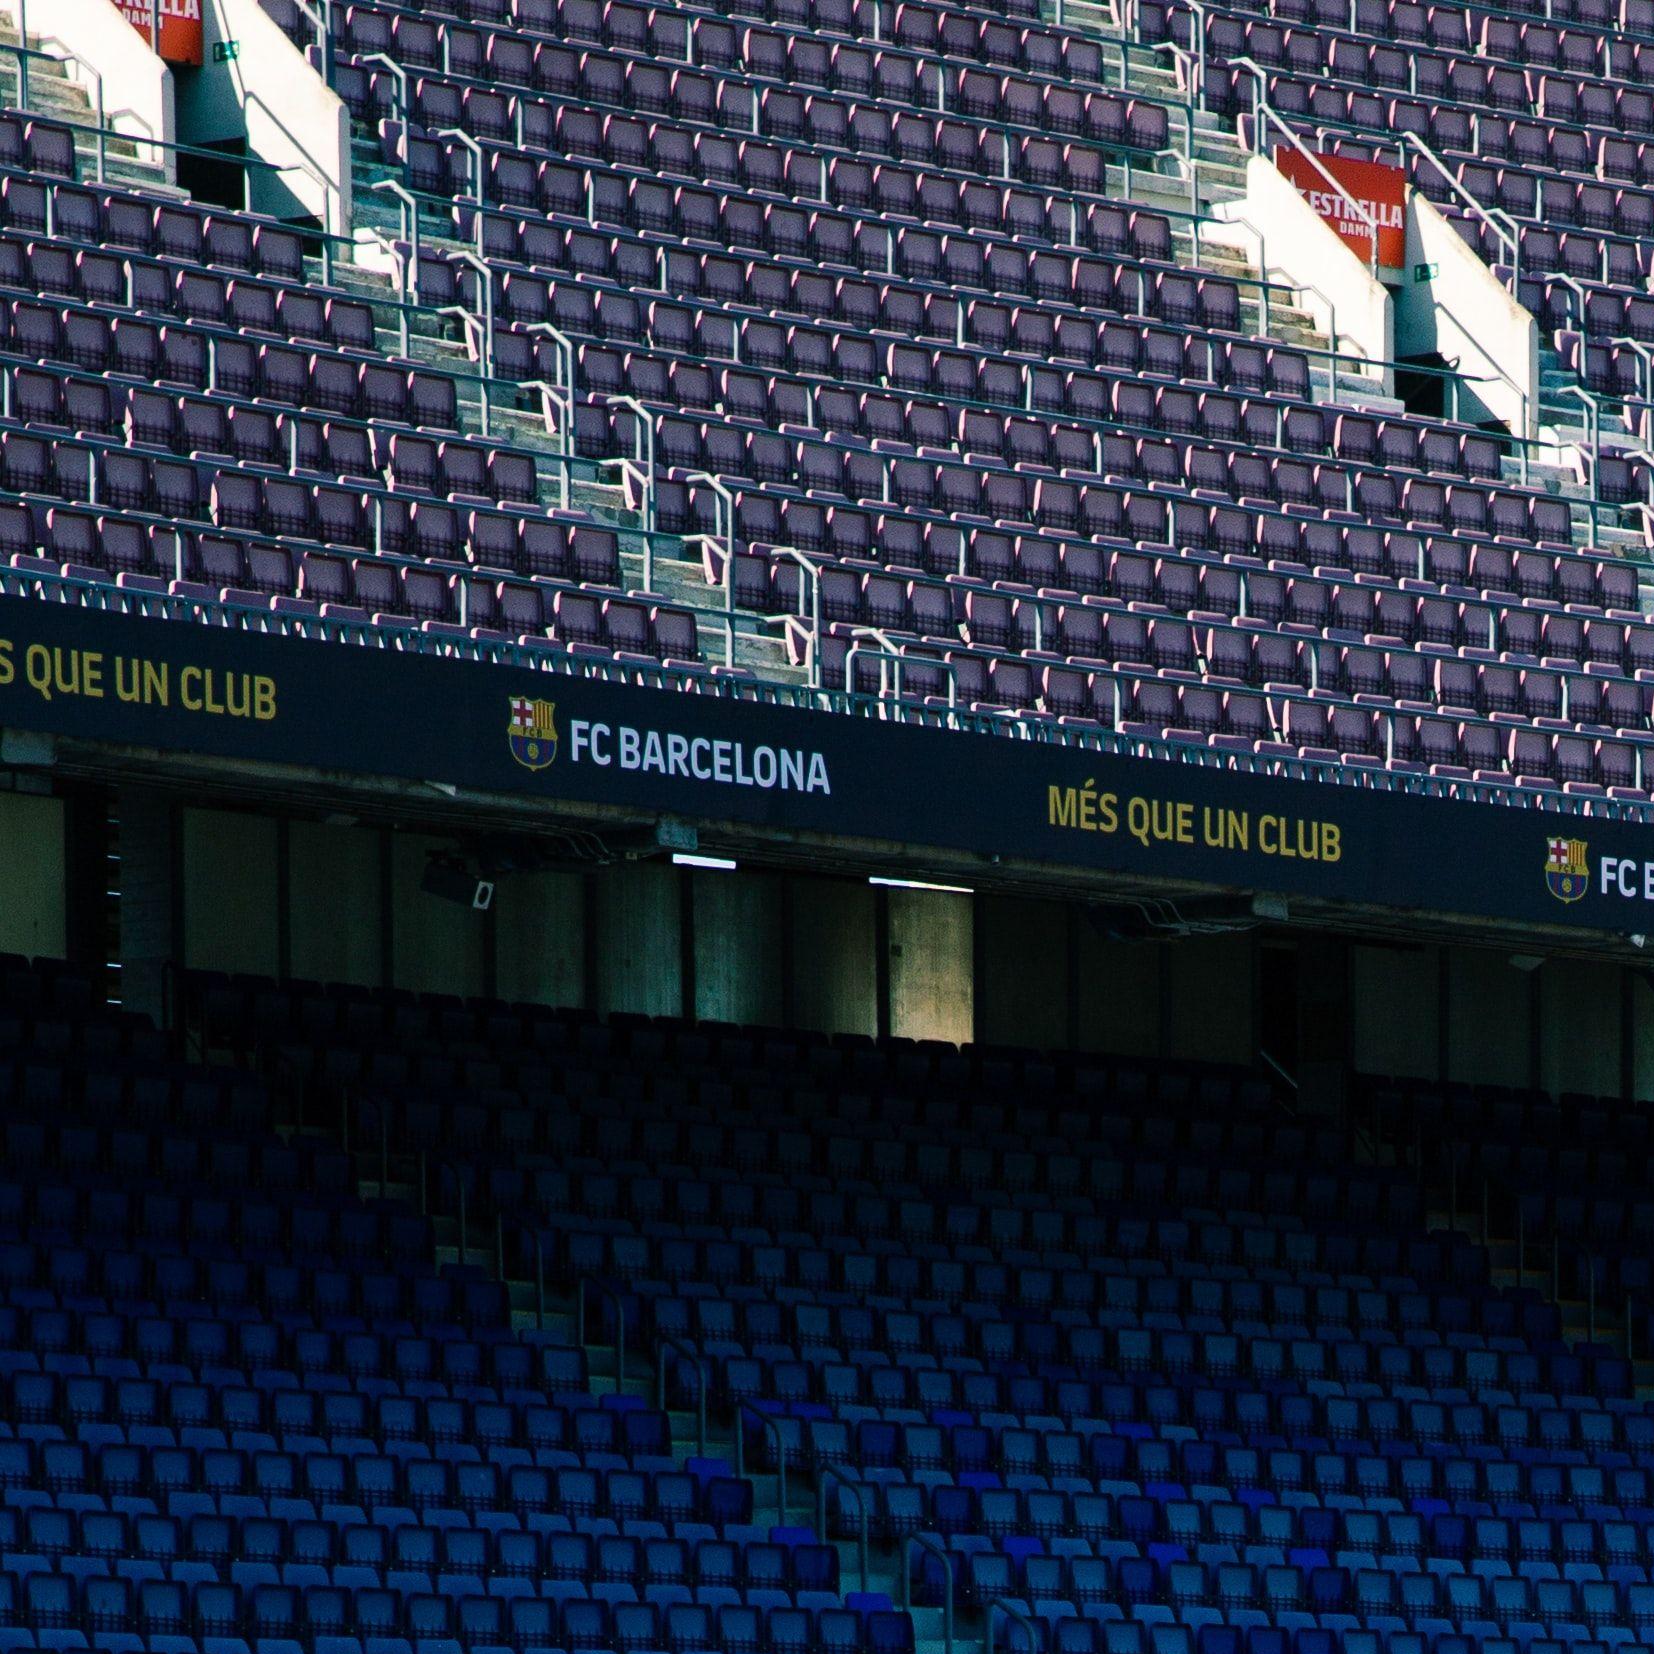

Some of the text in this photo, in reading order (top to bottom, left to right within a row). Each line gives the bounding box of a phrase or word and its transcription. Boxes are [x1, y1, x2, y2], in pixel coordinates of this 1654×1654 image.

[26, 643, 104, 700] QUE
[116, 656, 169, 706] UN
[180, 667, 278, 720] CLUB
[571, 718, 832, 796] FC BARCELONA
[1048, 779, 1343, 862] MÉS QUE UN CLUB
[1601, 856, 1637, 899] FC
